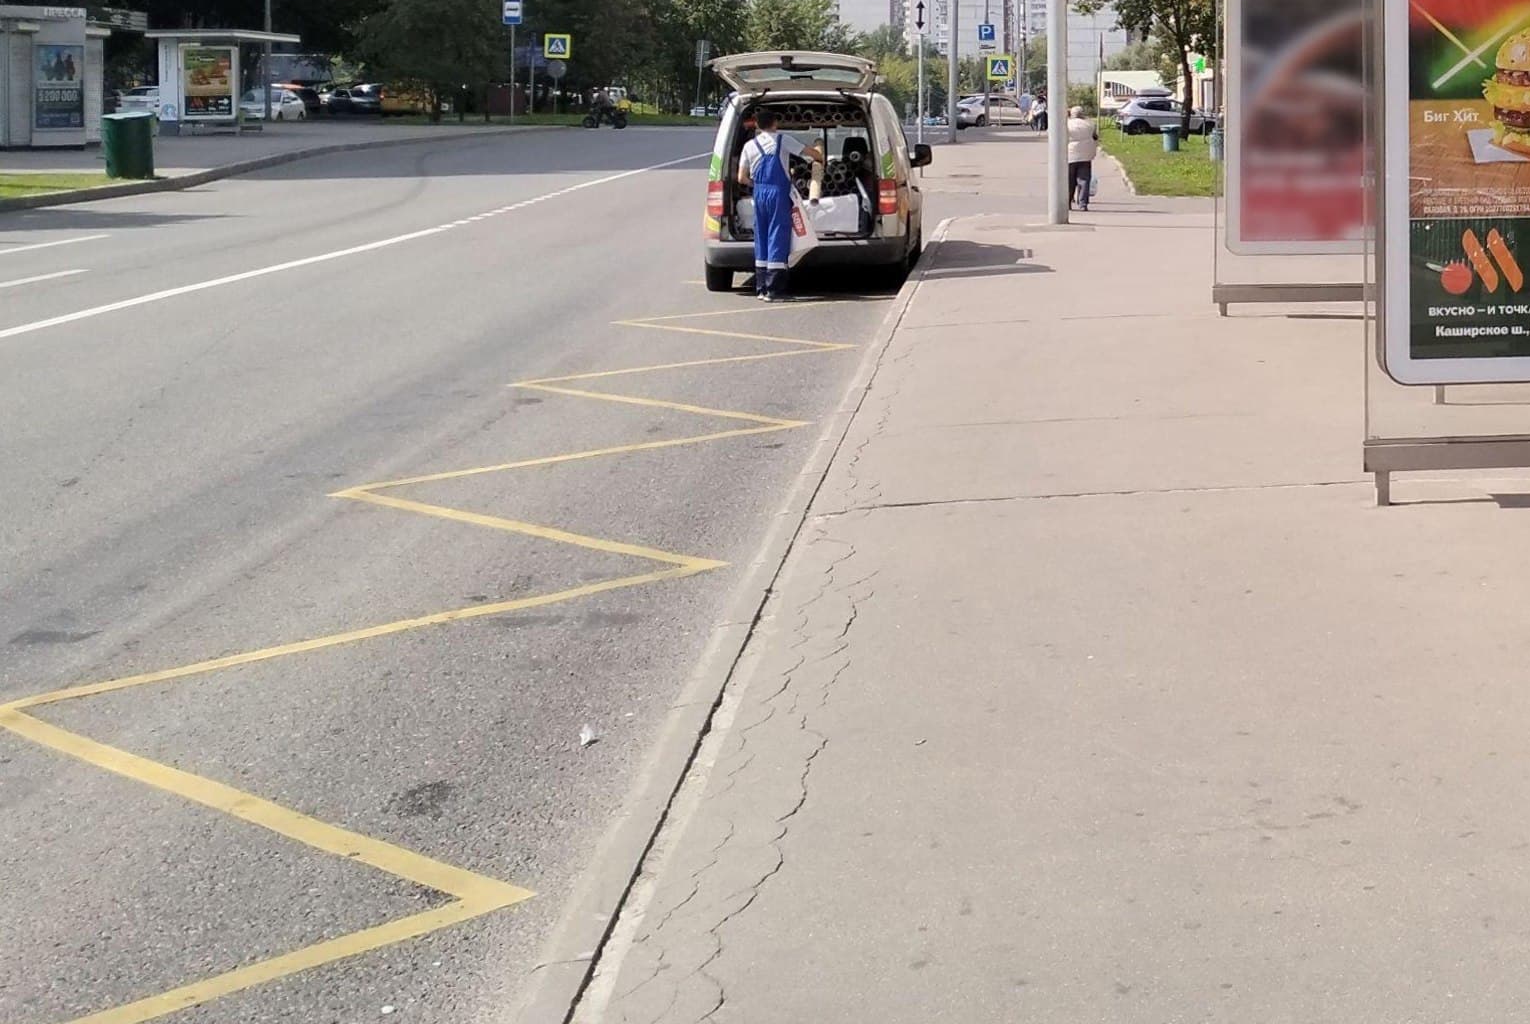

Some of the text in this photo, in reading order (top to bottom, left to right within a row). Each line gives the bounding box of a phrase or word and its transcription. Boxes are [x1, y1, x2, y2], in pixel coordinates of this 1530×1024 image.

[1424, 110, 1480, 122] Биг Хит
[1428, 306, 1475, 316] ВКУСНО
[1487, 305, 1496, 315] И
[1435, 325, 1509, 338] Каширское
[1511, 326, 1530, 336] ш.,
